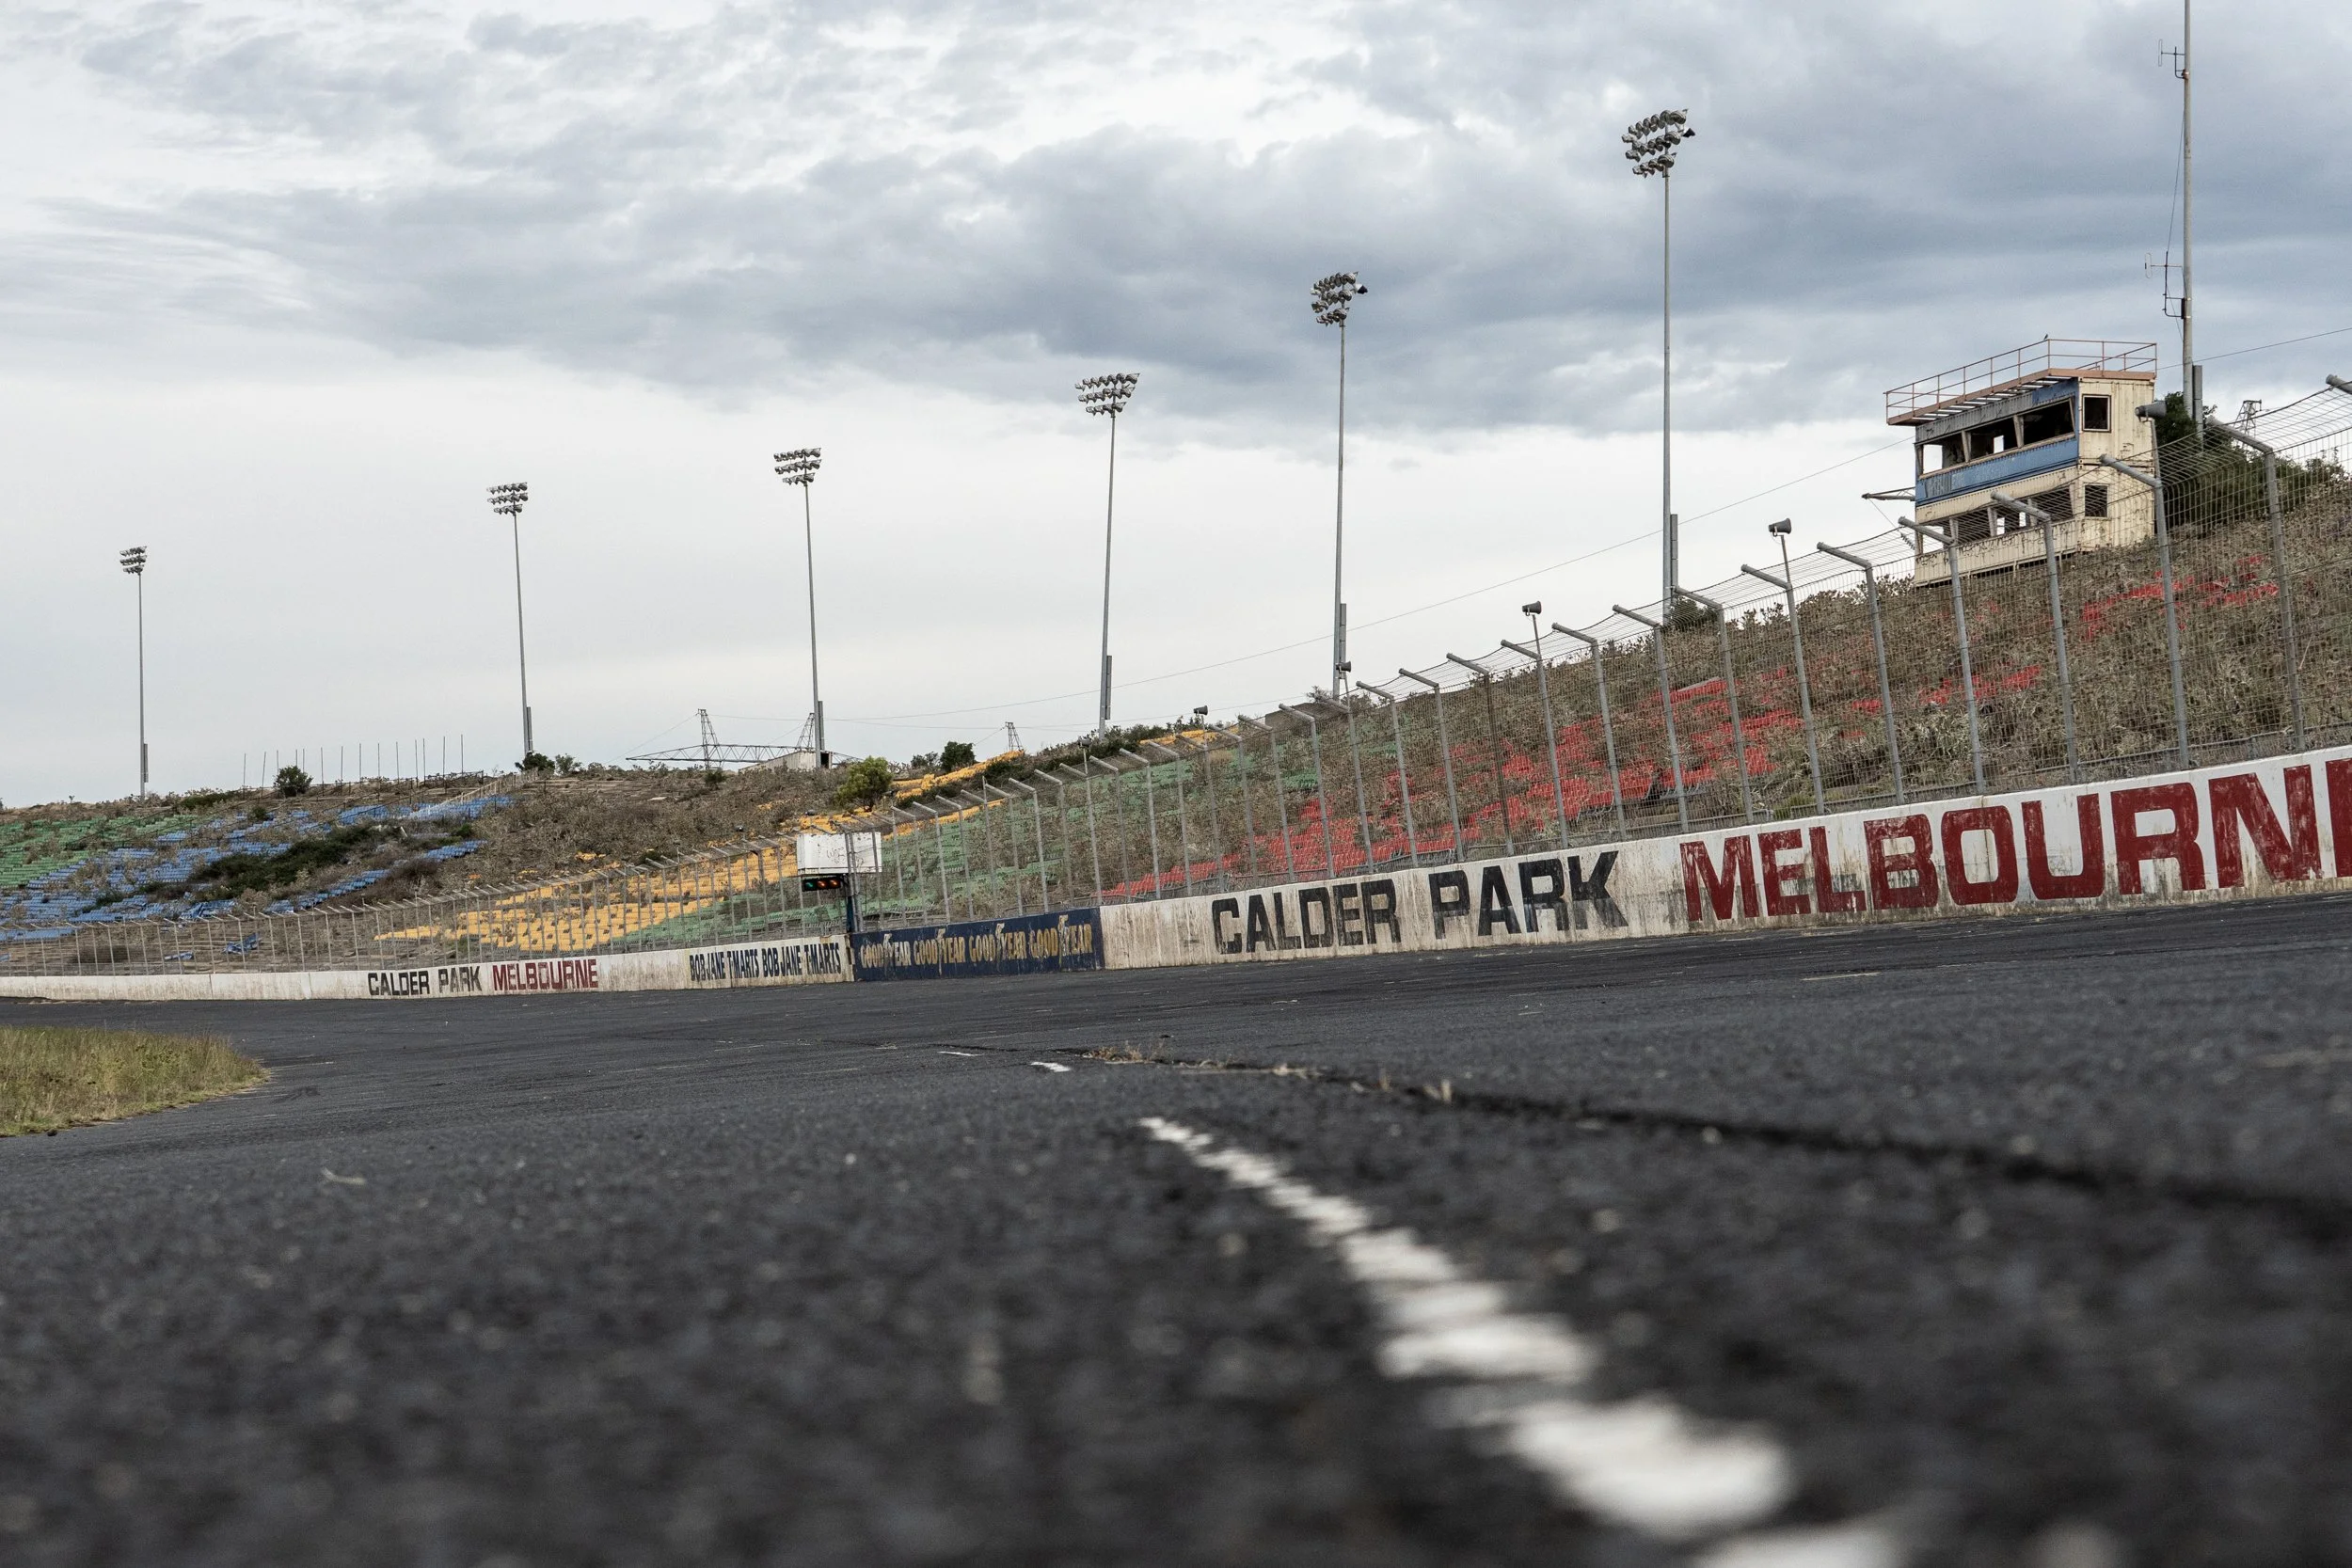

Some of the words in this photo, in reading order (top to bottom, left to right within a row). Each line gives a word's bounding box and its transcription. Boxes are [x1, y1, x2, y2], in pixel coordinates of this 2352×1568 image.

[1211, 879, 1401, 955] CALDER
[1428, 850, 1629, 940] PARK
[493, 959, 598, 990] MELBOURNE
[690, 953, 706, 981] BOB
[706, 951, 726, 980] JANE
[761, 947, 780, 977] BOB
[780, 944, 803, 976] JANE
[368, 970, 430, 995] CALDER
[438, 966, 482, 992] PARK
